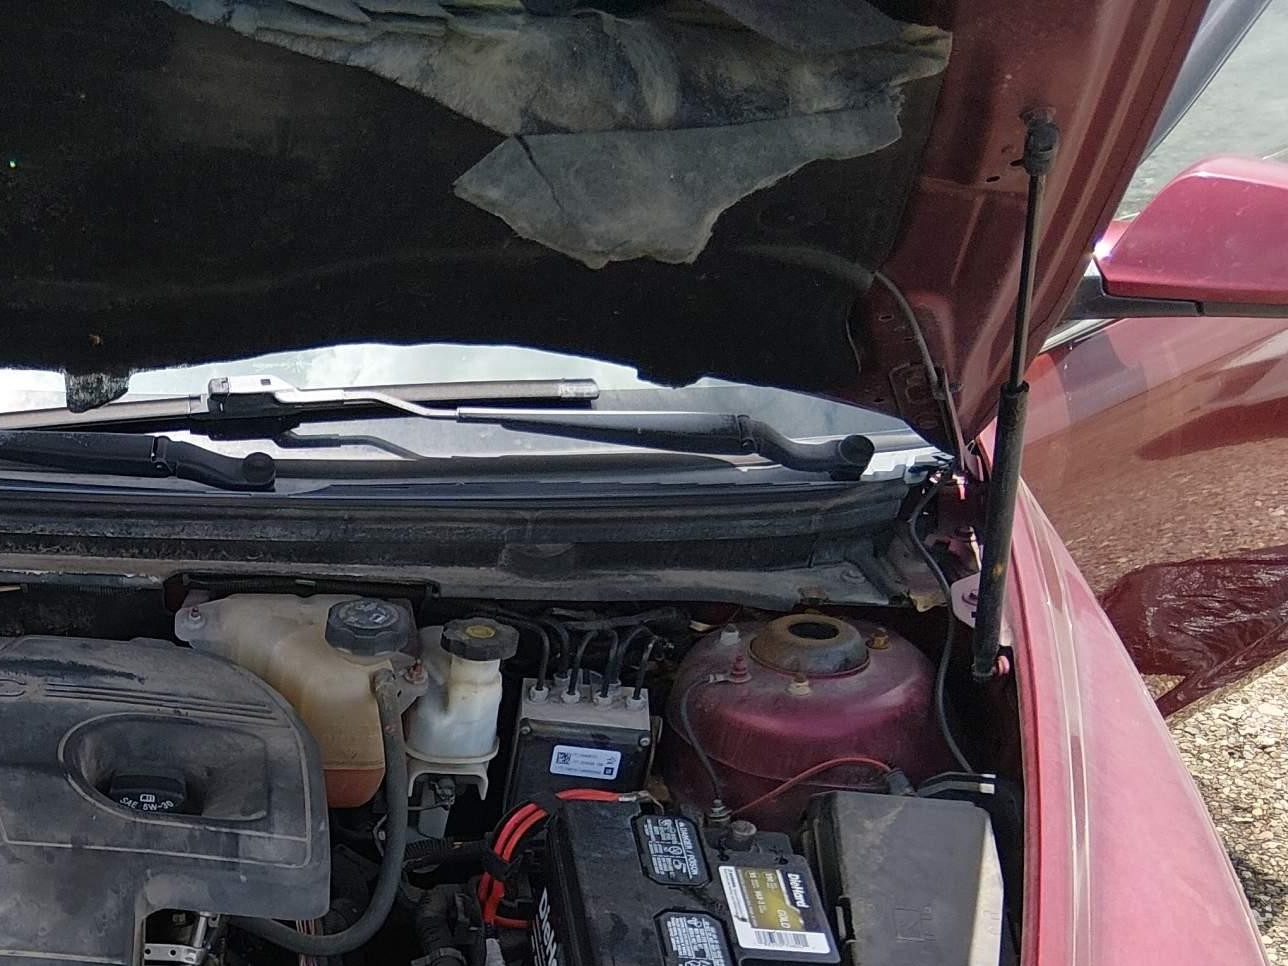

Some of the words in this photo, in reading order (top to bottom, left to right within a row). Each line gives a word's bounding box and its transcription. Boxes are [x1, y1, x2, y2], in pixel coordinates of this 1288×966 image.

[120, 796, 139, 809] SAE
[142, 800, 175, 811] 5W-30
[679, 827, 693, 850] DANGER
[686, 854, 698, 876] POISON
[788, 873, 810, 908] DieHard
[777, 909, 791, 929] GOLD
